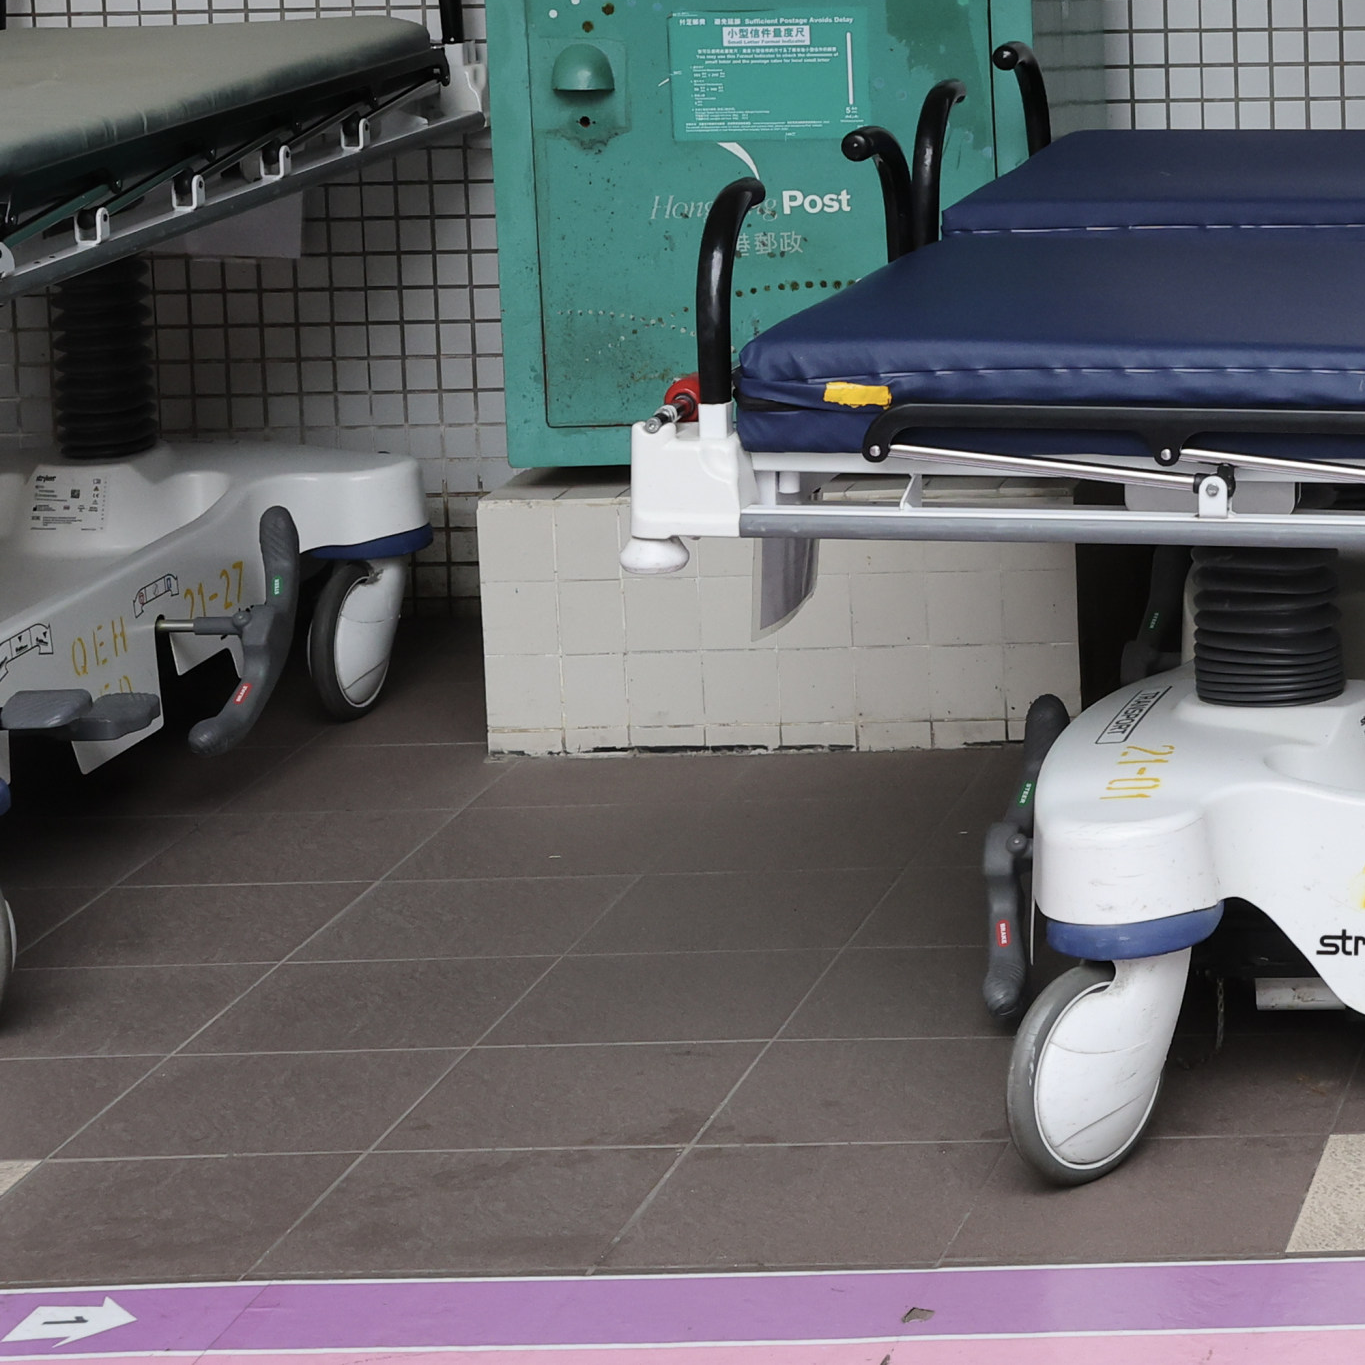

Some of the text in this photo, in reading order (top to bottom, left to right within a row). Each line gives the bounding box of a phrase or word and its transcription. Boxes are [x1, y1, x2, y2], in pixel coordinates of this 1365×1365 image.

[834, 16, 853, 24] Delay
[728, 28, 805, 38] 小型信件量度尺
[782, 189, 851, 214] Post
[72, 616, 128, 676] QEH
[1107, 690, 1160, 735] TRANSPORT
[1019, 783, 1032, 804] STEER
